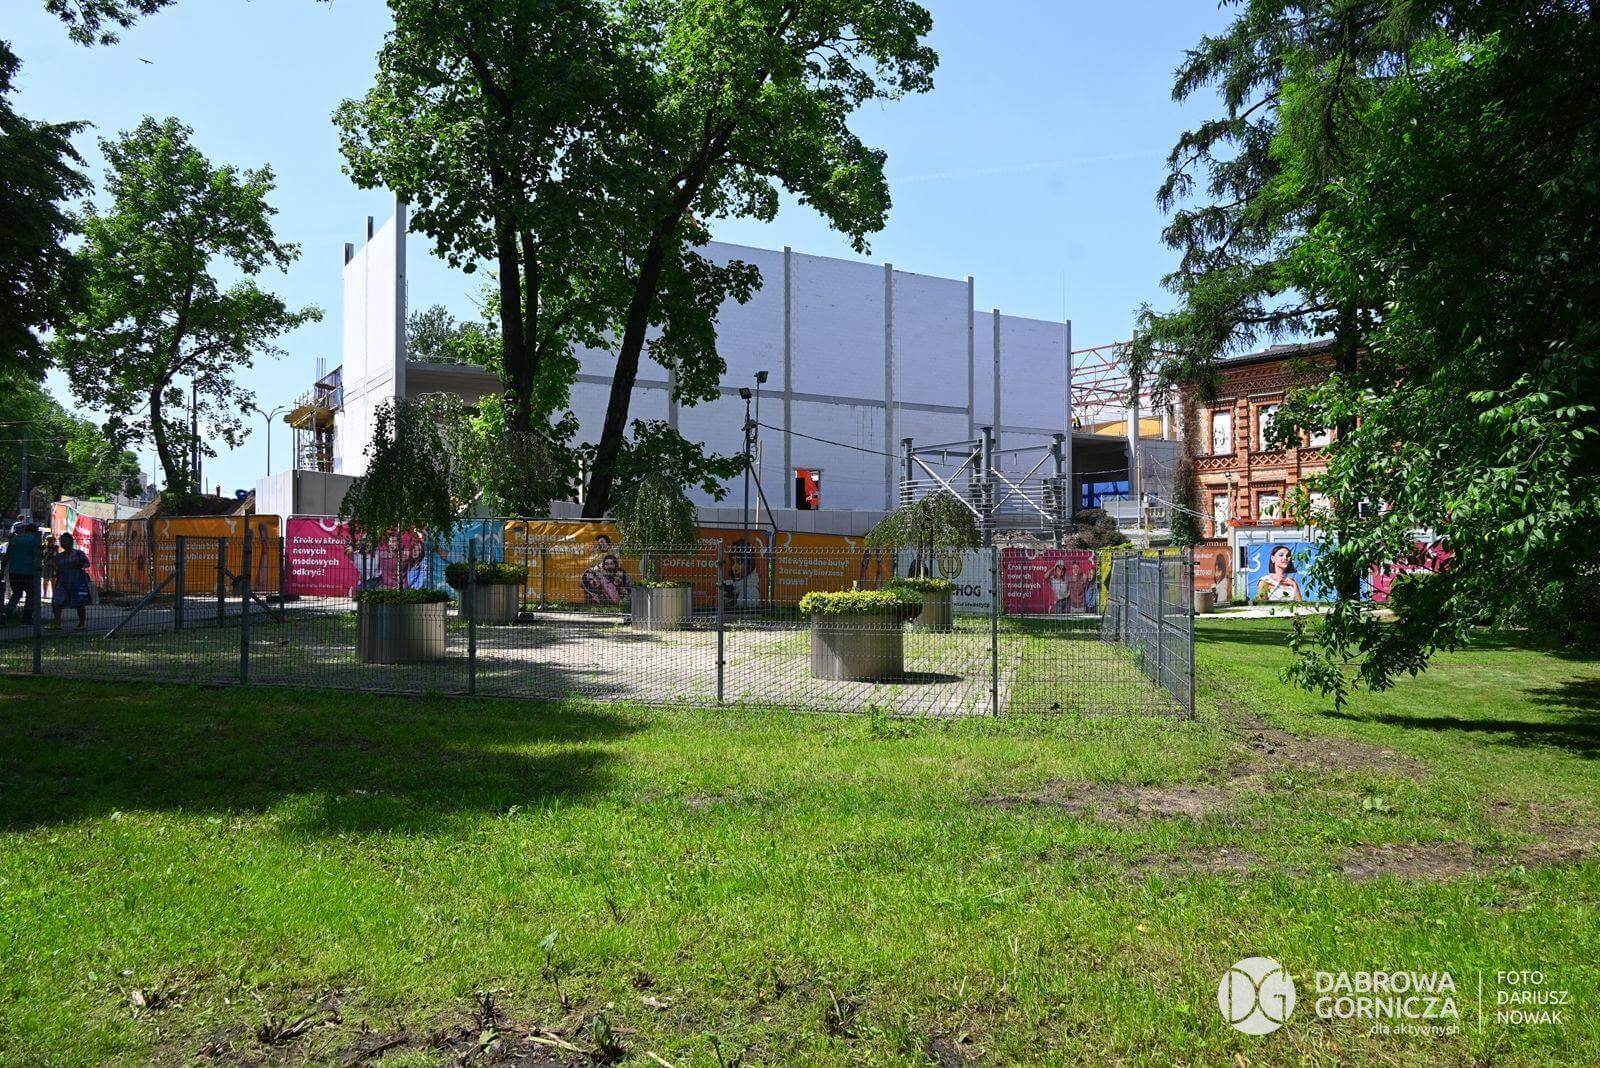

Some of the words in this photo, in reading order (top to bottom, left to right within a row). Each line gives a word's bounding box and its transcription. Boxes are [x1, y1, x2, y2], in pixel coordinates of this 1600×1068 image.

[293, 536, 313, 544] Krok
[292, 547, 326, 556] nowych
[292, 558, 339, 567] modowych
[952, 584, 982, 597] HOG
